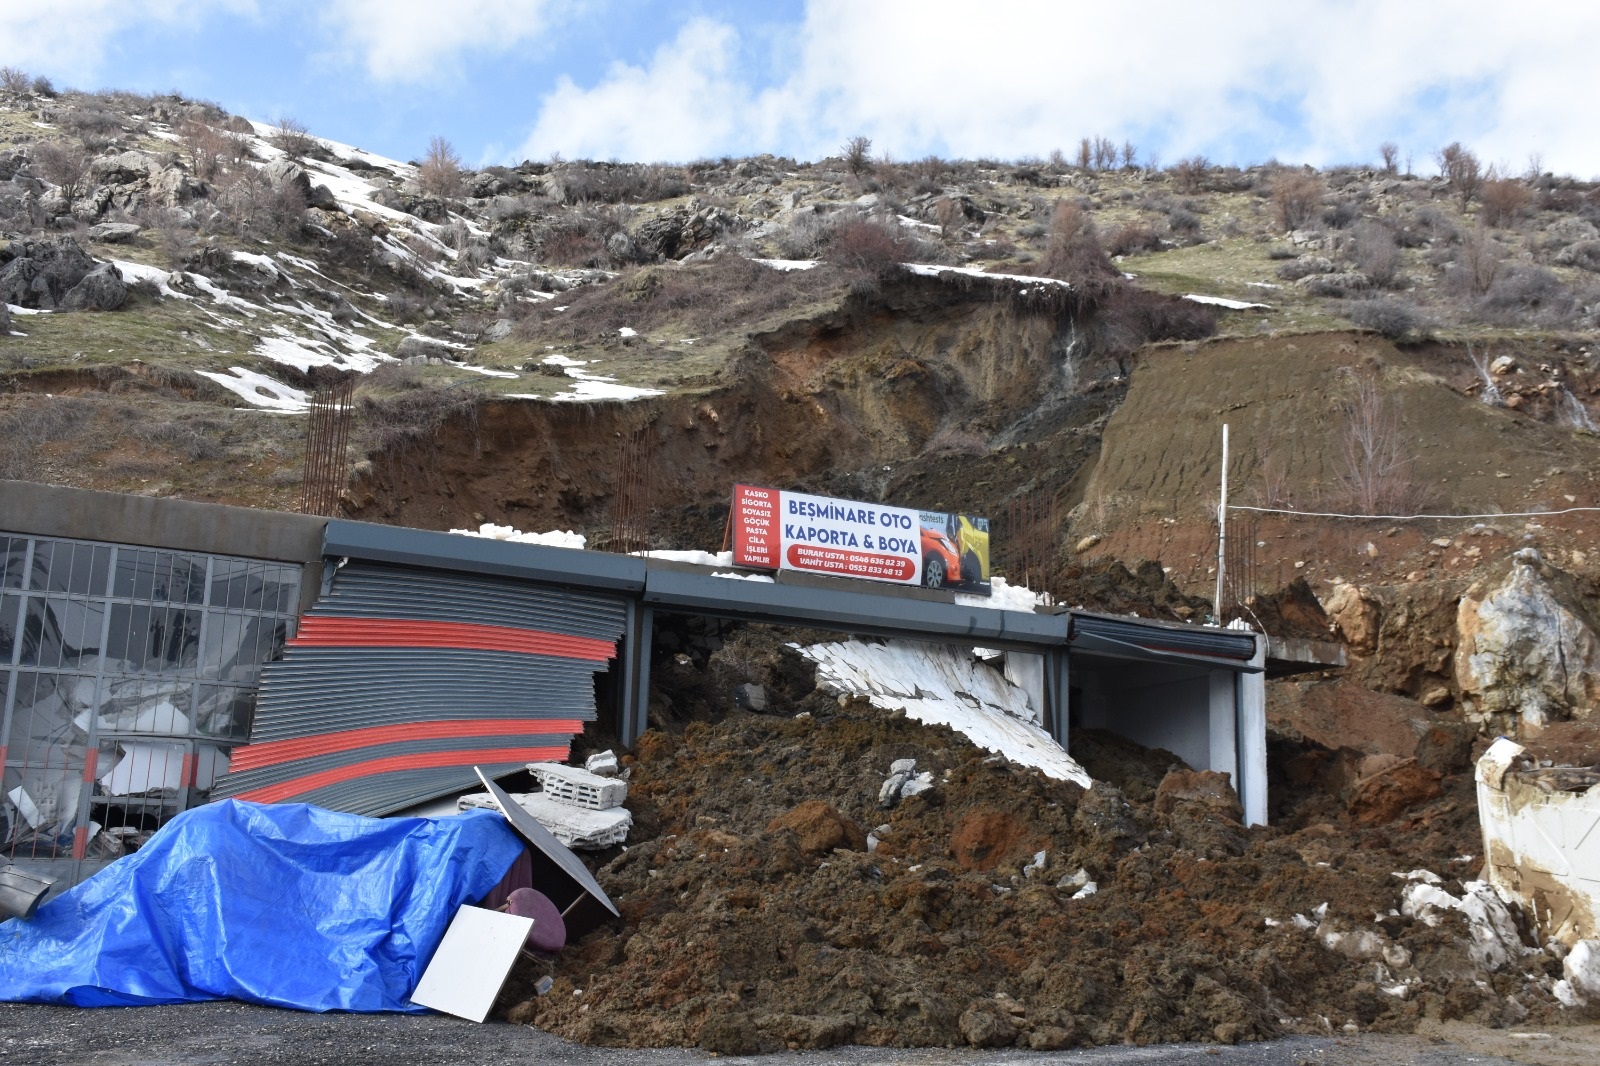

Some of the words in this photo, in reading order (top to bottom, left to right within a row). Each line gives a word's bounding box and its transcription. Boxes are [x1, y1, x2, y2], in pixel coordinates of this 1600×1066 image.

[745, 489, 769, 498] KASKO
[741, 498, 773, 508] SİGORTA
[742, 508, 772, 518] BOYASIZ
[789, 500, 876, 525] BEŞMİNARE
[880, 512, 912, 530] OTO
[744, 516, 770, 527] GÖÇÜK
[746, 526, 768, 535] PASTA
[748, 535, 766, 545] CİLA
[785, 524, 859, 548] KAPORTA
[863, 534, 875, 549] &
[879, 536, 918, 554] BOYA
[746, 544, 768, 554] İŞLERİ
[744, 554, 770, 564] YAPILIR
[797, 548, 824, 558] BURAK
[825, 551, 845, 560] USTA
[850, 555, 869, 563] 0546
[800, 558, 823, 566] VAHİT
[824, 561, 844, 569] USTA
